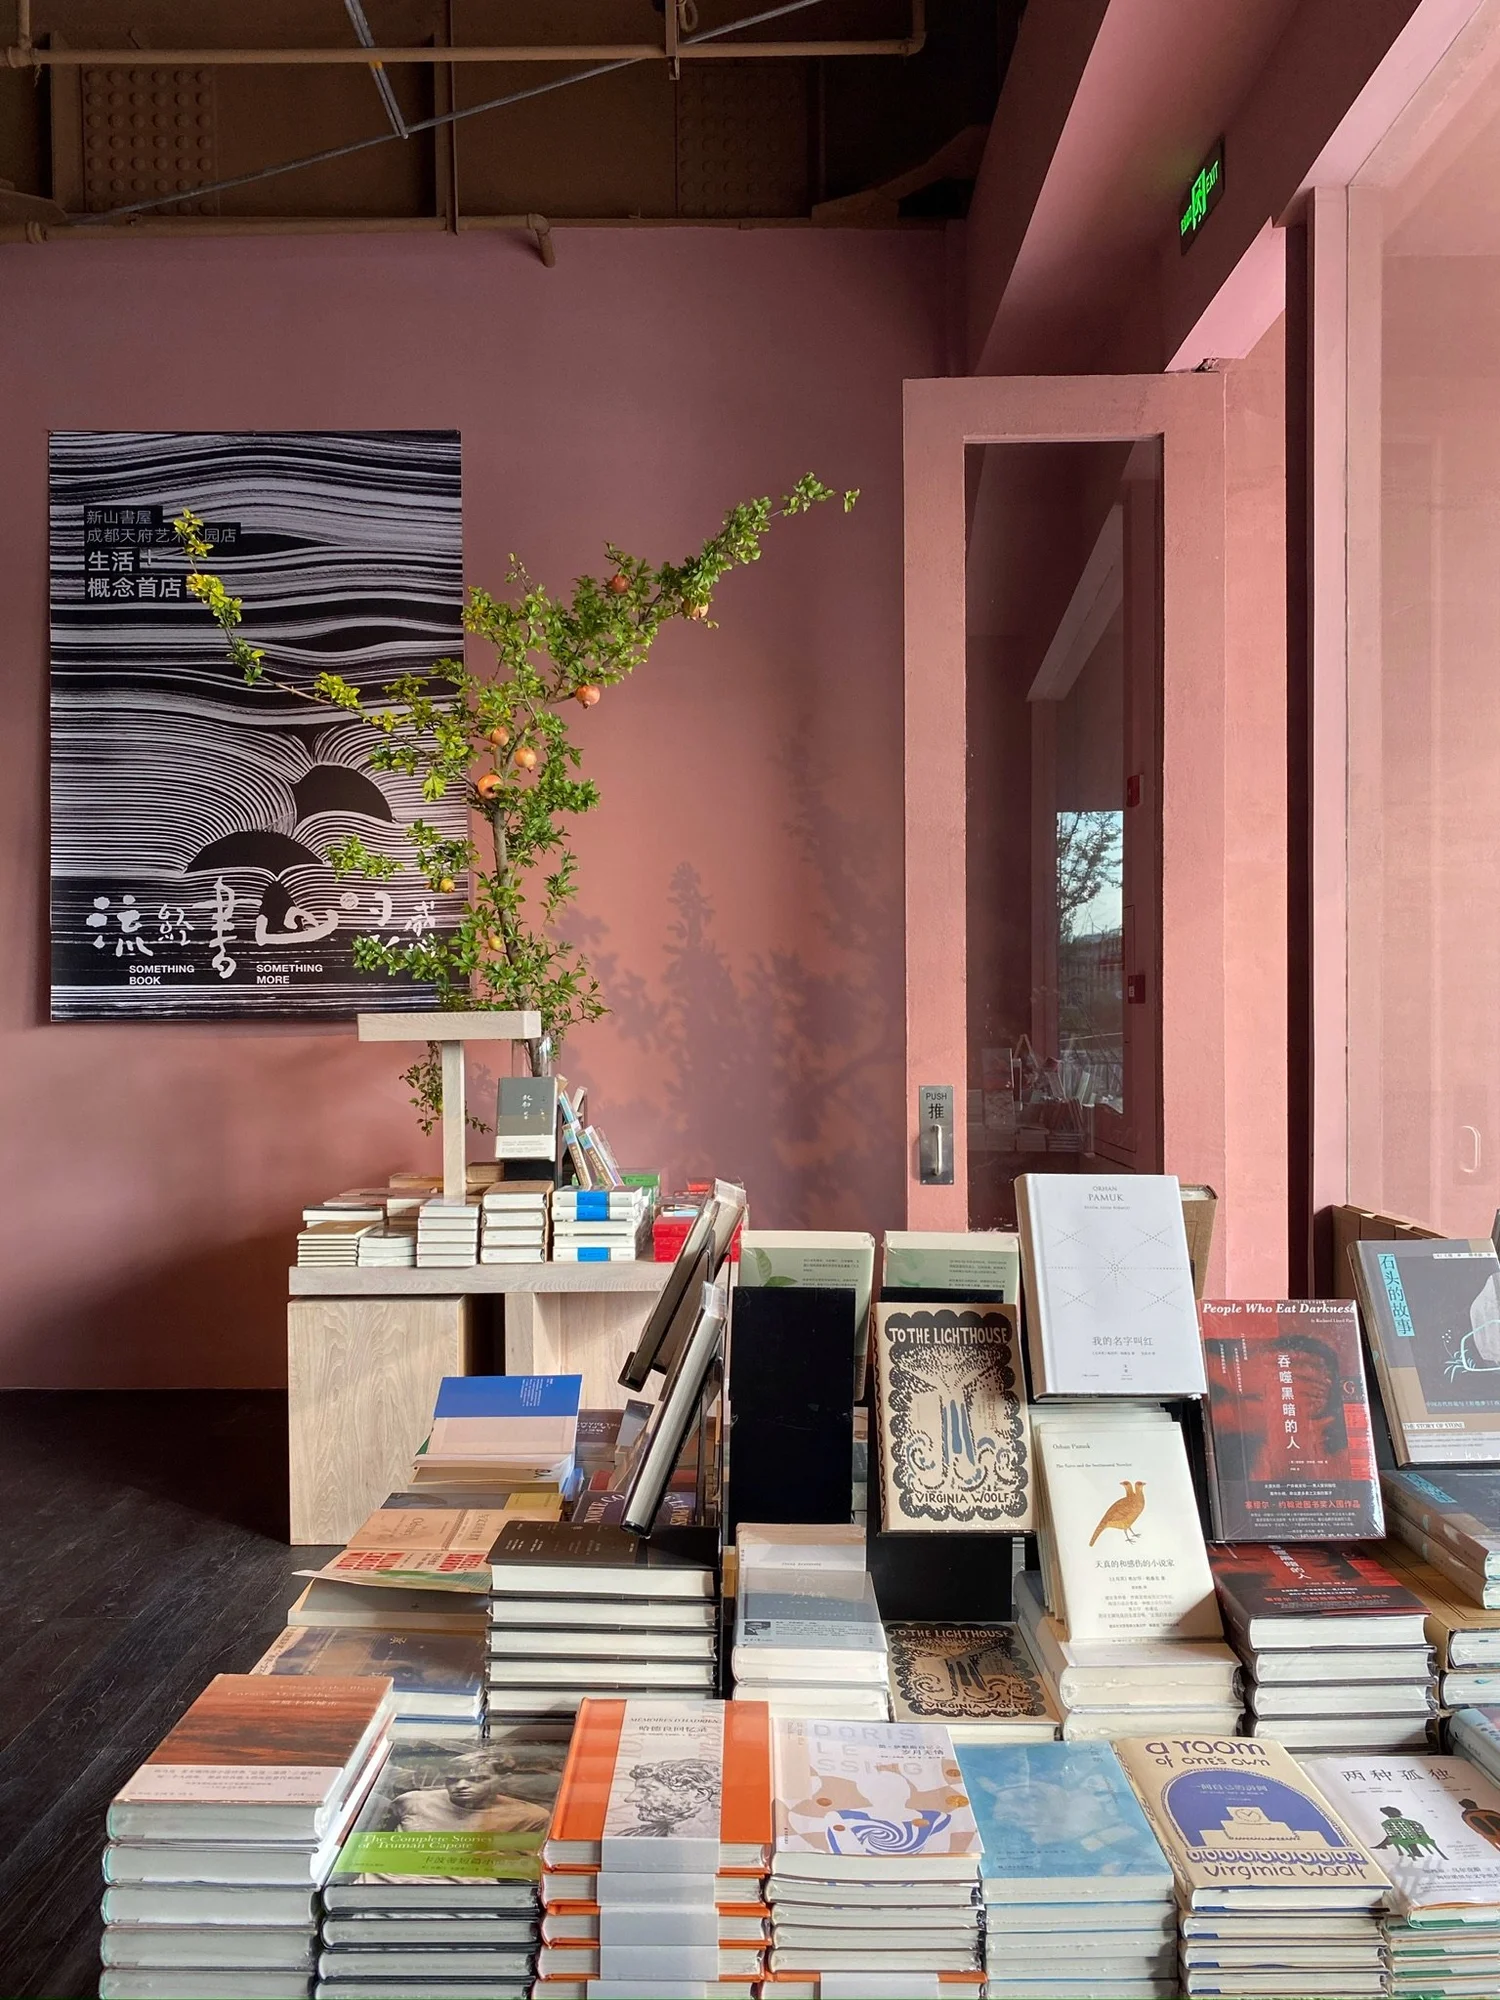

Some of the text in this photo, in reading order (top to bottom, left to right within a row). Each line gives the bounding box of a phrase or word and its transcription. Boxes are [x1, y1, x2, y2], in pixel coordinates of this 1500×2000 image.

[1205, 160, 1219, 195] EXIT
[86, 510, 152, 524] 新山書屋
[86, 528, 237, 543] 成都天府艺术园店
[87, 577, 182, 598] 概念首店
[129, 964, 195, 974] SOMETHING
[256, 963, 323, 973] SOMETHING
[129, 975, 161, 985] BOOK
[256, 975, 290, 985] MORE
[925, 1092, 948, 1101] PUSH
[928, 1103, 945, 1119] 推
[1088, 1193, 1124, 1202] PAMUK
[1381, 1254, 1413, 1335] 石头的故事
[1203, 1303, 1355, 1314] People Who Eat Darkness
[889, 1327, 1008, 1344] TO THE LIGHTHOUSE
[1092, 1336, 1153, 1346] 我的名字叫红
[1277, 1354, 1300, 1450] 吞噬黑暗的人
[915, 1491, 1010, 1504] VIRGINIA WOOLF
[1095, 1559, 1175, 1569] 天真的和感伤的小说家
[1145, 1740, 1266, 1756] a room
[1155, 1755, 1271, 1768] of one's own
[363, 1834, 494, 1844] The Complete Stories
[357, 1841, 472, 1851] of Truman Capote
